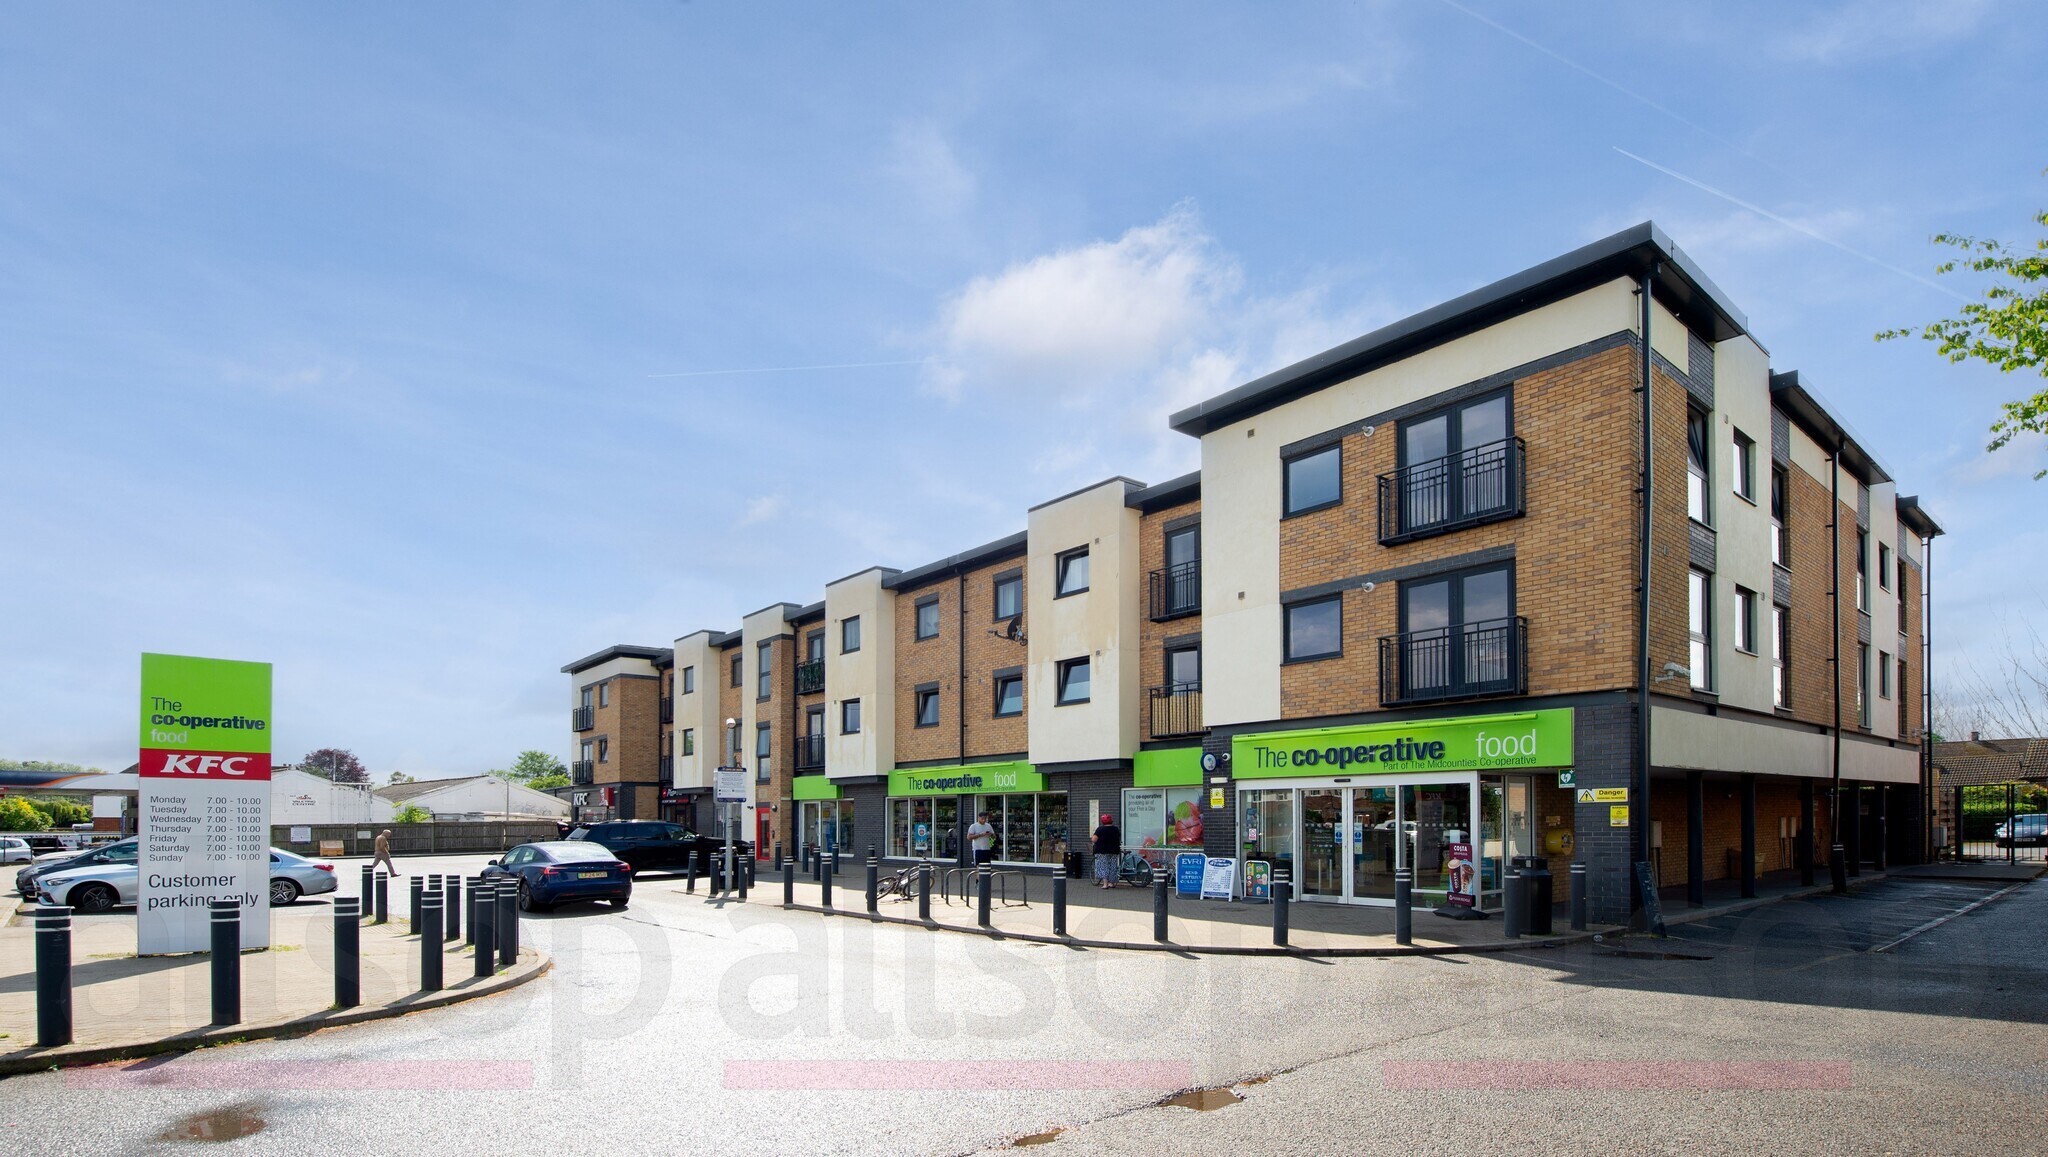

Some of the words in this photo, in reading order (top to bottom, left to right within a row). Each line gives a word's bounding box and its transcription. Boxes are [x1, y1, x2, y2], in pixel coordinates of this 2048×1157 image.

[151, 697, 182, 712] The
[151, 714, 265, 730] co-operative
[151, 729, 187, 743] food
[1254, 747, 1287, 768] The
[1292, 738, 1445, 769] co-operative
[1475, 729, 1536, 757] food
[160, 754, 249, 775] KFC
[1384, 762, 1398, 770] Part
[1400, 761, 1408, 769] of
[1410, 760, 1424, 769] The
[1428, 758, 1476, 768] Midcounties
[1480, 756, 1537, 767] Co-operative
[908, 776, 922, 790] The
[923, 774, 982, 792] co-operative
[994, 771, 1016, 787] food
[150, 796, 186, 804] Monday
[573, 792, 588, 806] KFC
[150, 805, 187, 814] Tuesday
[150, 815, 201, 824] Wednesday
[150, 825, 192, 833] Thursday
[150, 835, 177, 843] Friday
[150, 844, 190, 853] Saturday
[149, 854, 183, 863] Sunday
[148, 874, 236, 888] Customer
[148, 893, 216, 911] parking
